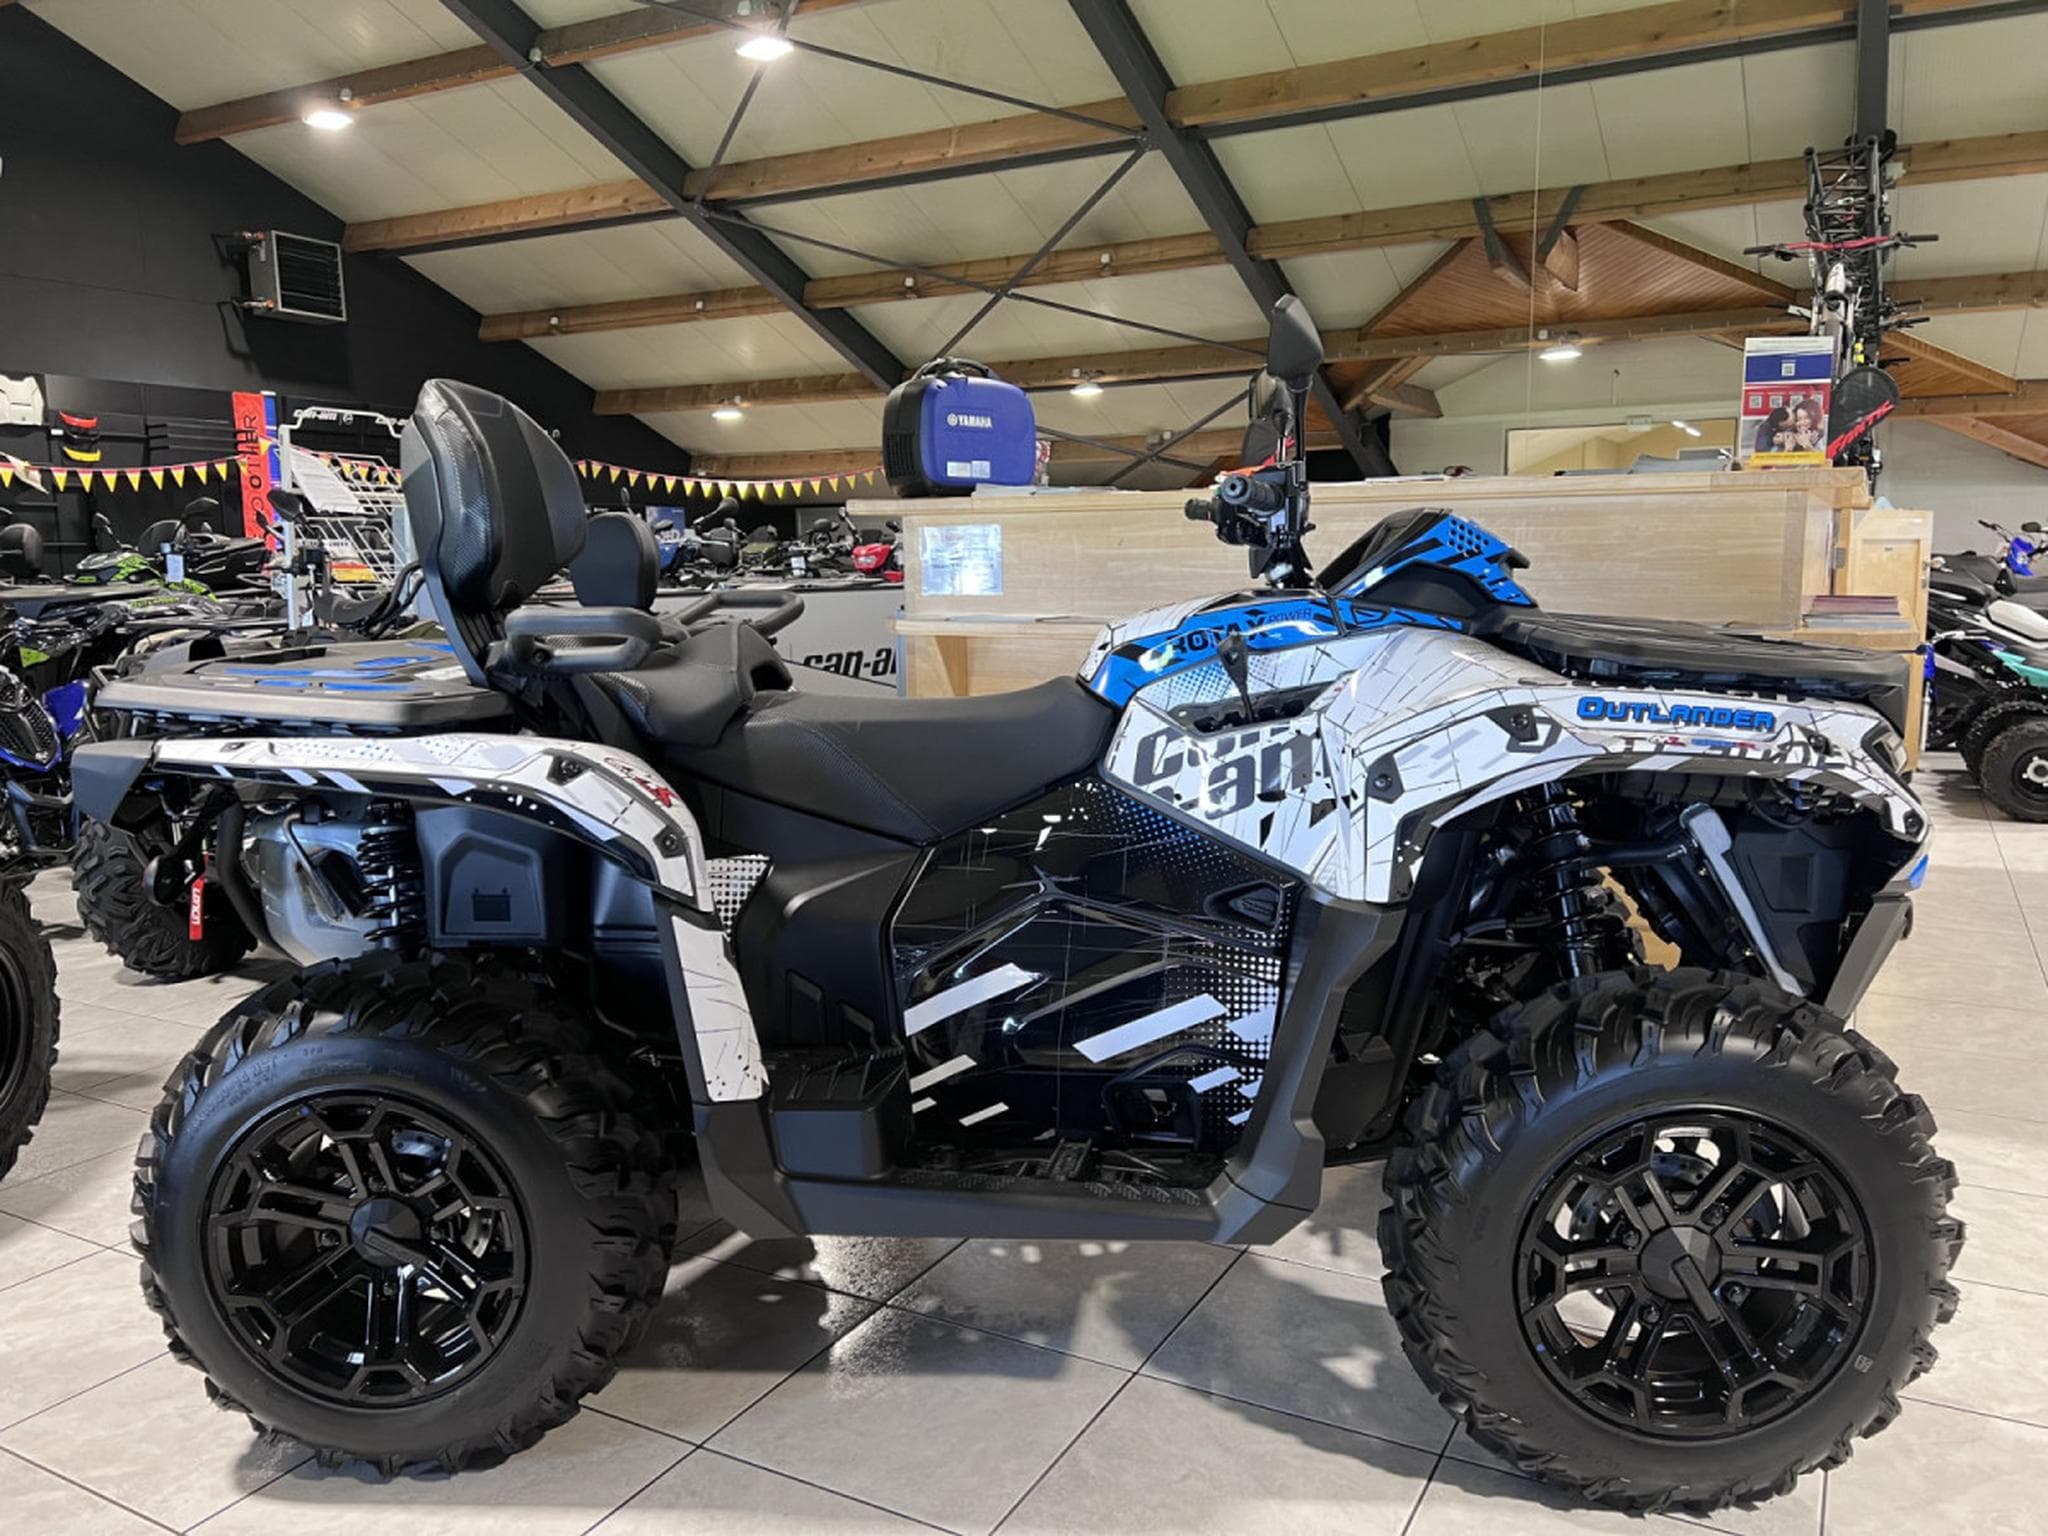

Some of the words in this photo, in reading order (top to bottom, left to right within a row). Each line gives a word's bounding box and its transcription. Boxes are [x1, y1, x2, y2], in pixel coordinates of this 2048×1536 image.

[957, 413, 993, 429] YAMAHA
[1167, 615, 1270, 654] ROTAX
[1268, 607, 1313, 624] POWER
[803, 647, 897, 678] can-a
[1577, 695, 1776, 732] OUTLANDER
